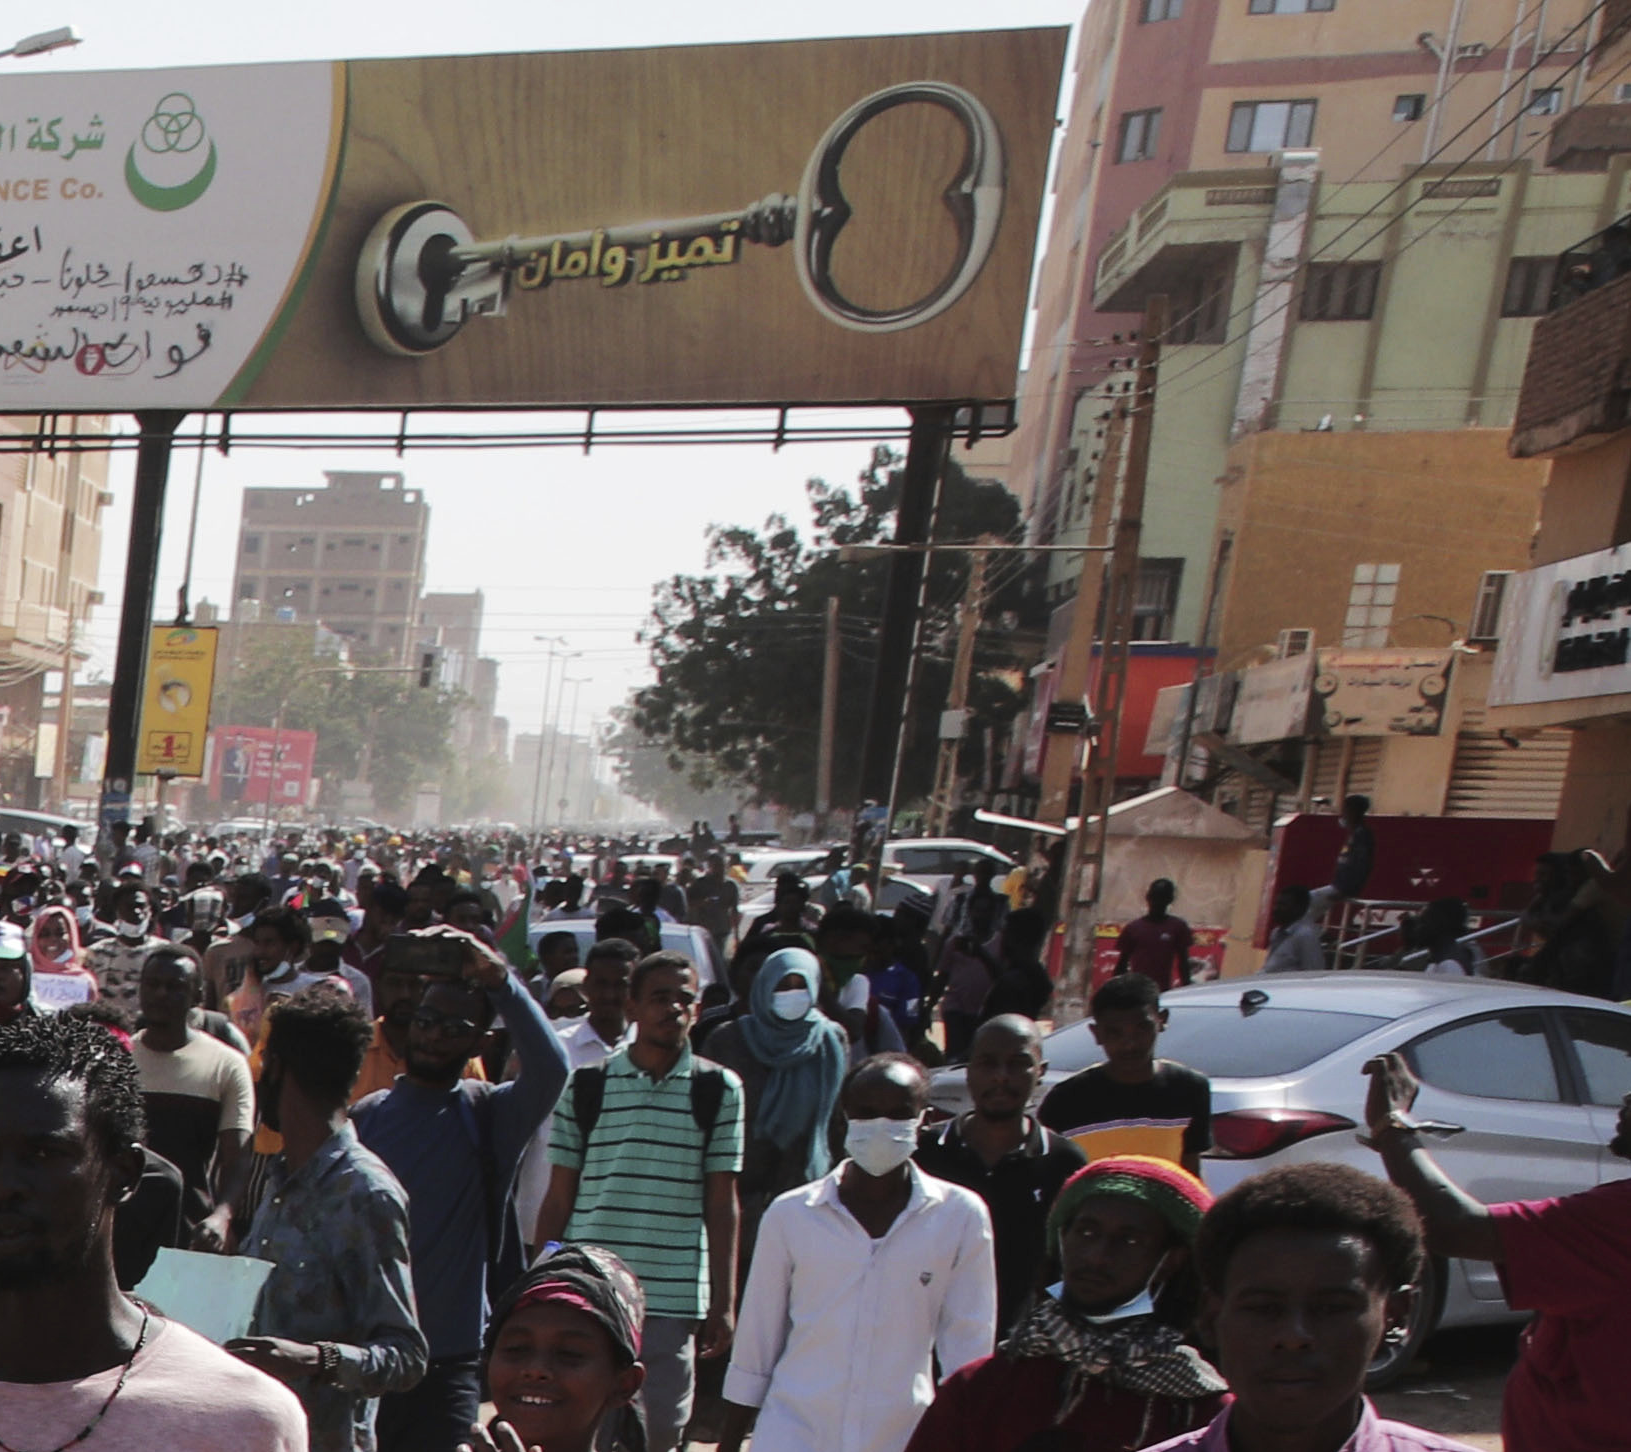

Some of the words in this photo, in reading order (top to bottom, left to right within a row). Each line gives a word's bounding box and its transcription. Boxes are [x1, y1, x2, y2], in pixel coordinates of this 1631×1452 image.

[27, 115, 105, 159] شركة
[60, 177, 104, 200] Co.
[518, 226, 626, 289] وأمان
[640, 219, 741, 284] تميز
